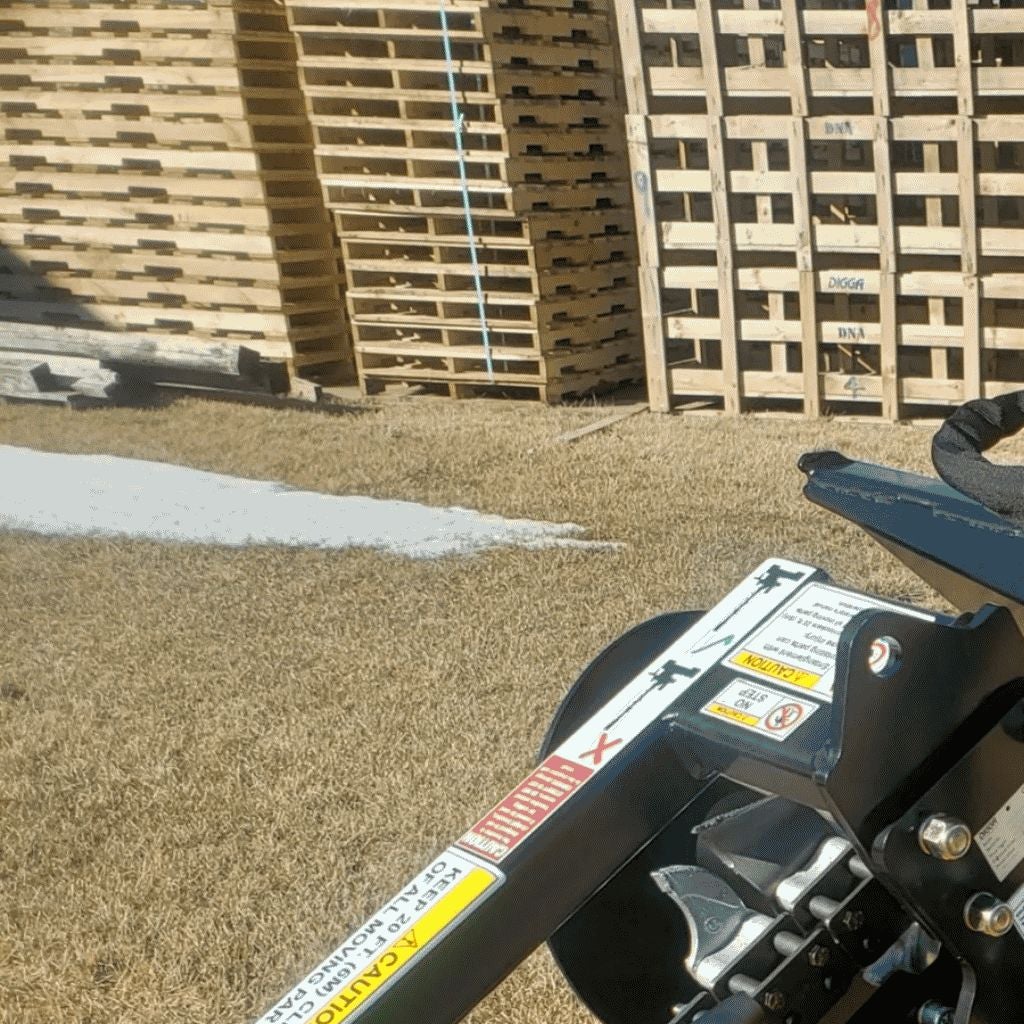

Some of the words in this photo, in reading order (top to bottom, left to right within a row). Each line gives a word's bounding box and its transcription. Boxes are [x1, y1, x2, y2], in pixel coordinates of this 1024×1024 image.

[828, 276, 865, 291] DIGGA
[837, 326, 866, 339] DNA
[743, 655, 796, 679] CAUTION
[734, 699, 754, 709] NO
[738, 688, 768, 703] STEP
[424, 861, 447, 885] OF
[383, 885, 418, 914] ALL
[415, 867, 462, 911] KEEP
[388, 913, 412, 933] 20
[308, 919, 384, 985] MOVING
[357, 936, 387, 959] FT.
[315, 962, 357, 997] (6M)
